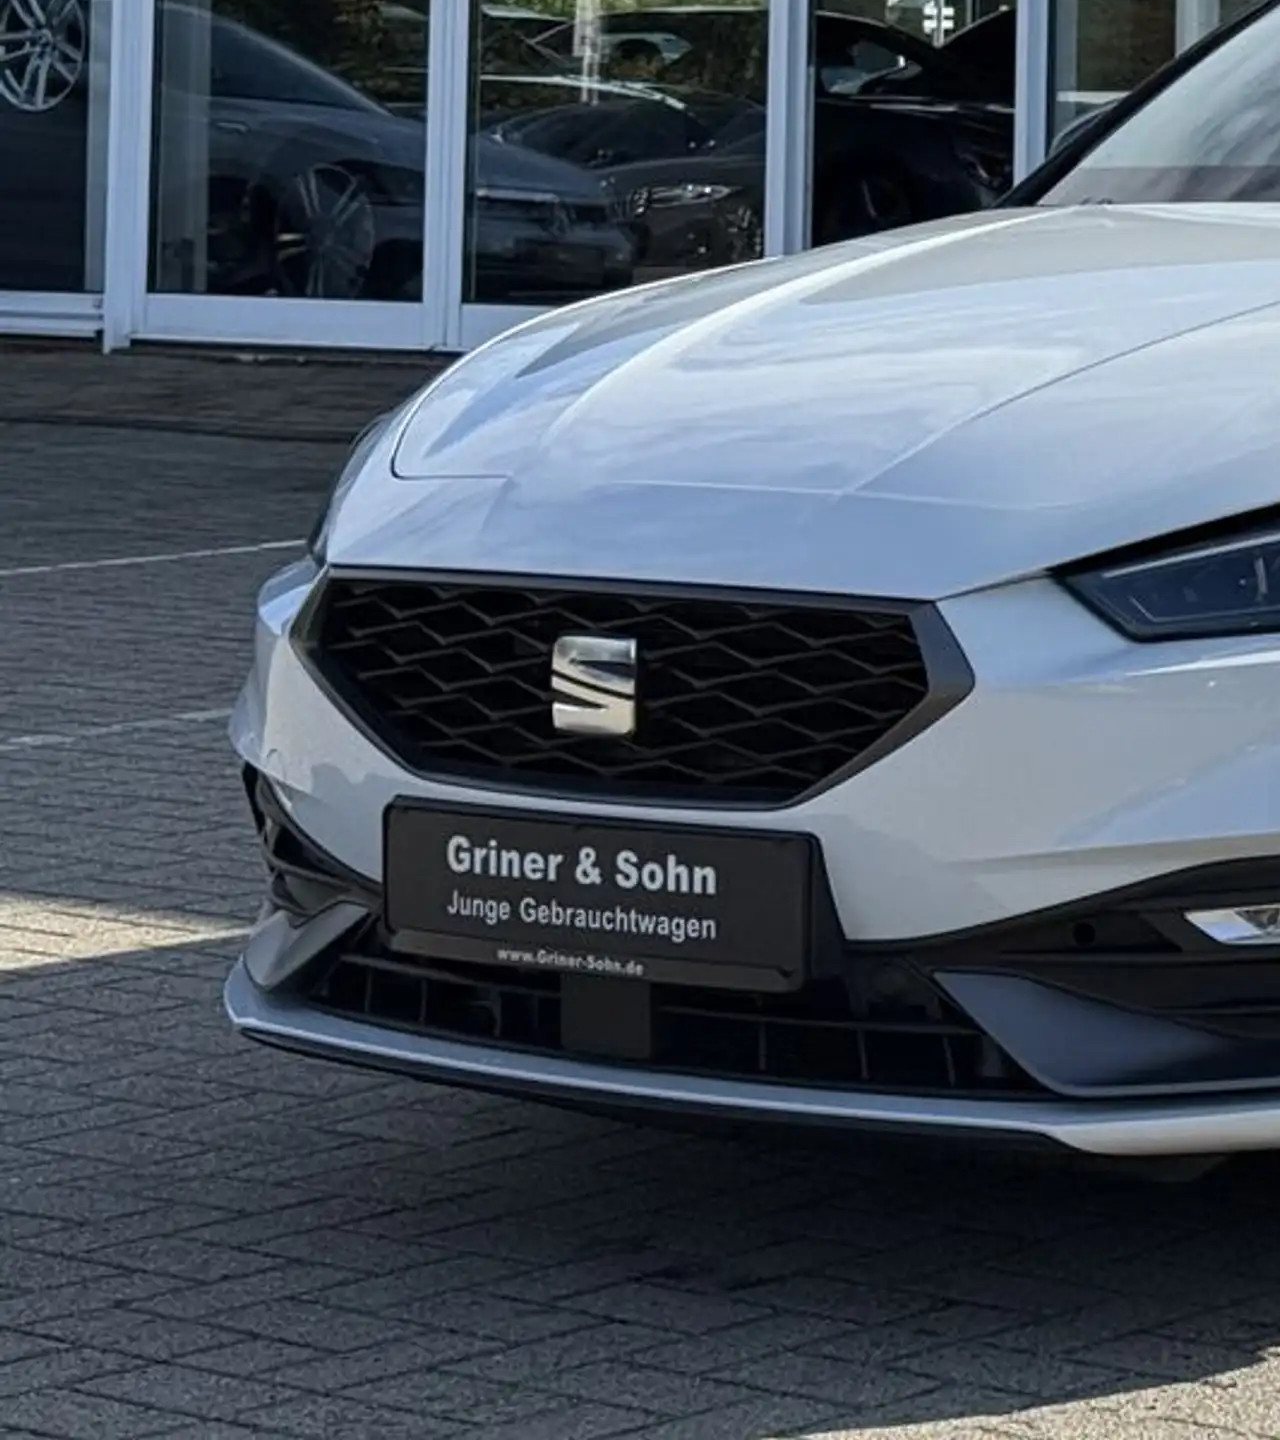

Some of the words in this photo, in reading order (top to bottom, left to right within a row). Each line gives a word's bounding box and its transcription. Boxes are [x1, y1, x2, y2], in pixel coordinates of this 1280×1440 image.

[446, 834, 564, 882] Griner
[575, 845, 602, 886] &
[615, 849, 717, 896] Sohn
[446, 889, 511, 926] Junge
[519, 896, 717, 944] Gebrauchtwagen
